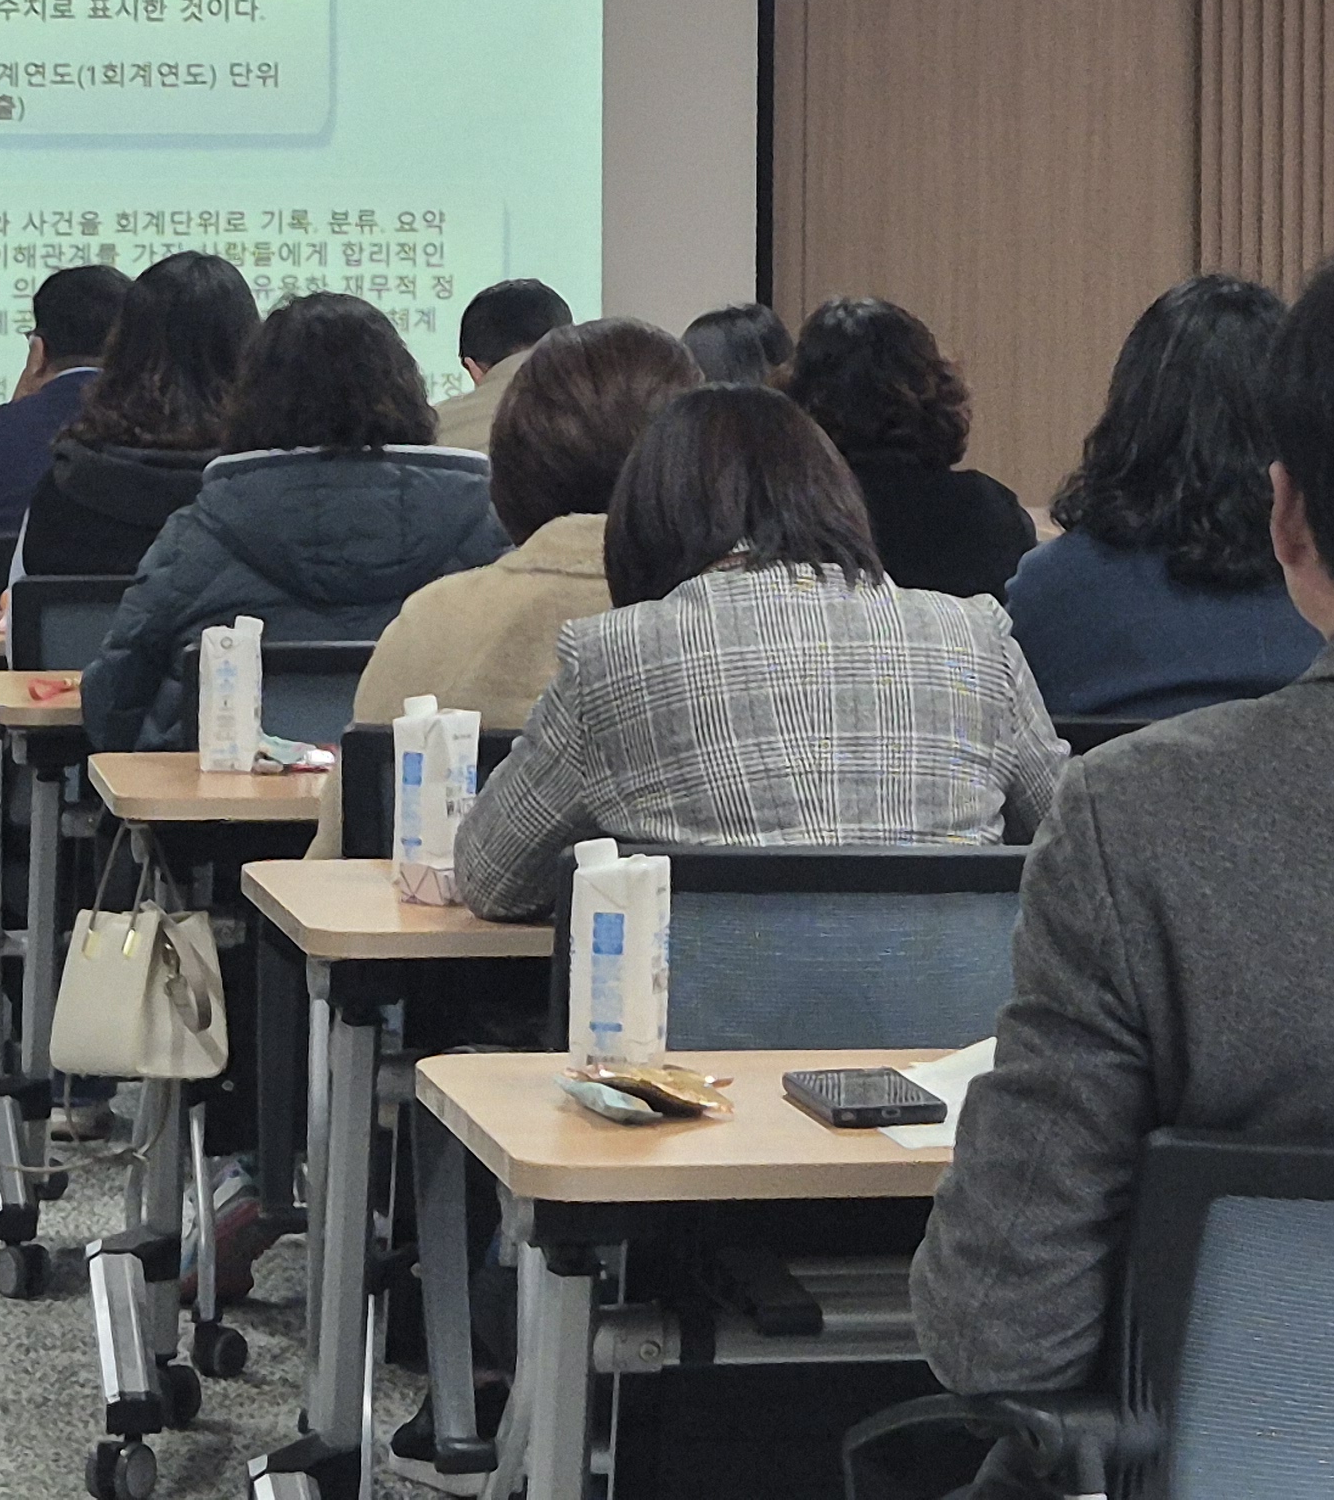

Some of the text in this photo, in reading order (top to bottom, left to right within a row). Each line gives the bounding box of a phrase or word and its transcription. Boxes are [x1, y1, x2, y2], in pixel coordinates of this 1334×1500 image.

[228, 61, 280, 88] 단위
[21, 210, 103, 237] 사건을
[115, 209, 248, 237] 회계단위로
[395, 209, 446, 236] 요약
[342, 241, 446, 269] 합리적인
[342, 274, 418, 301] 재무적
[432, 274, 455, 301] 정
